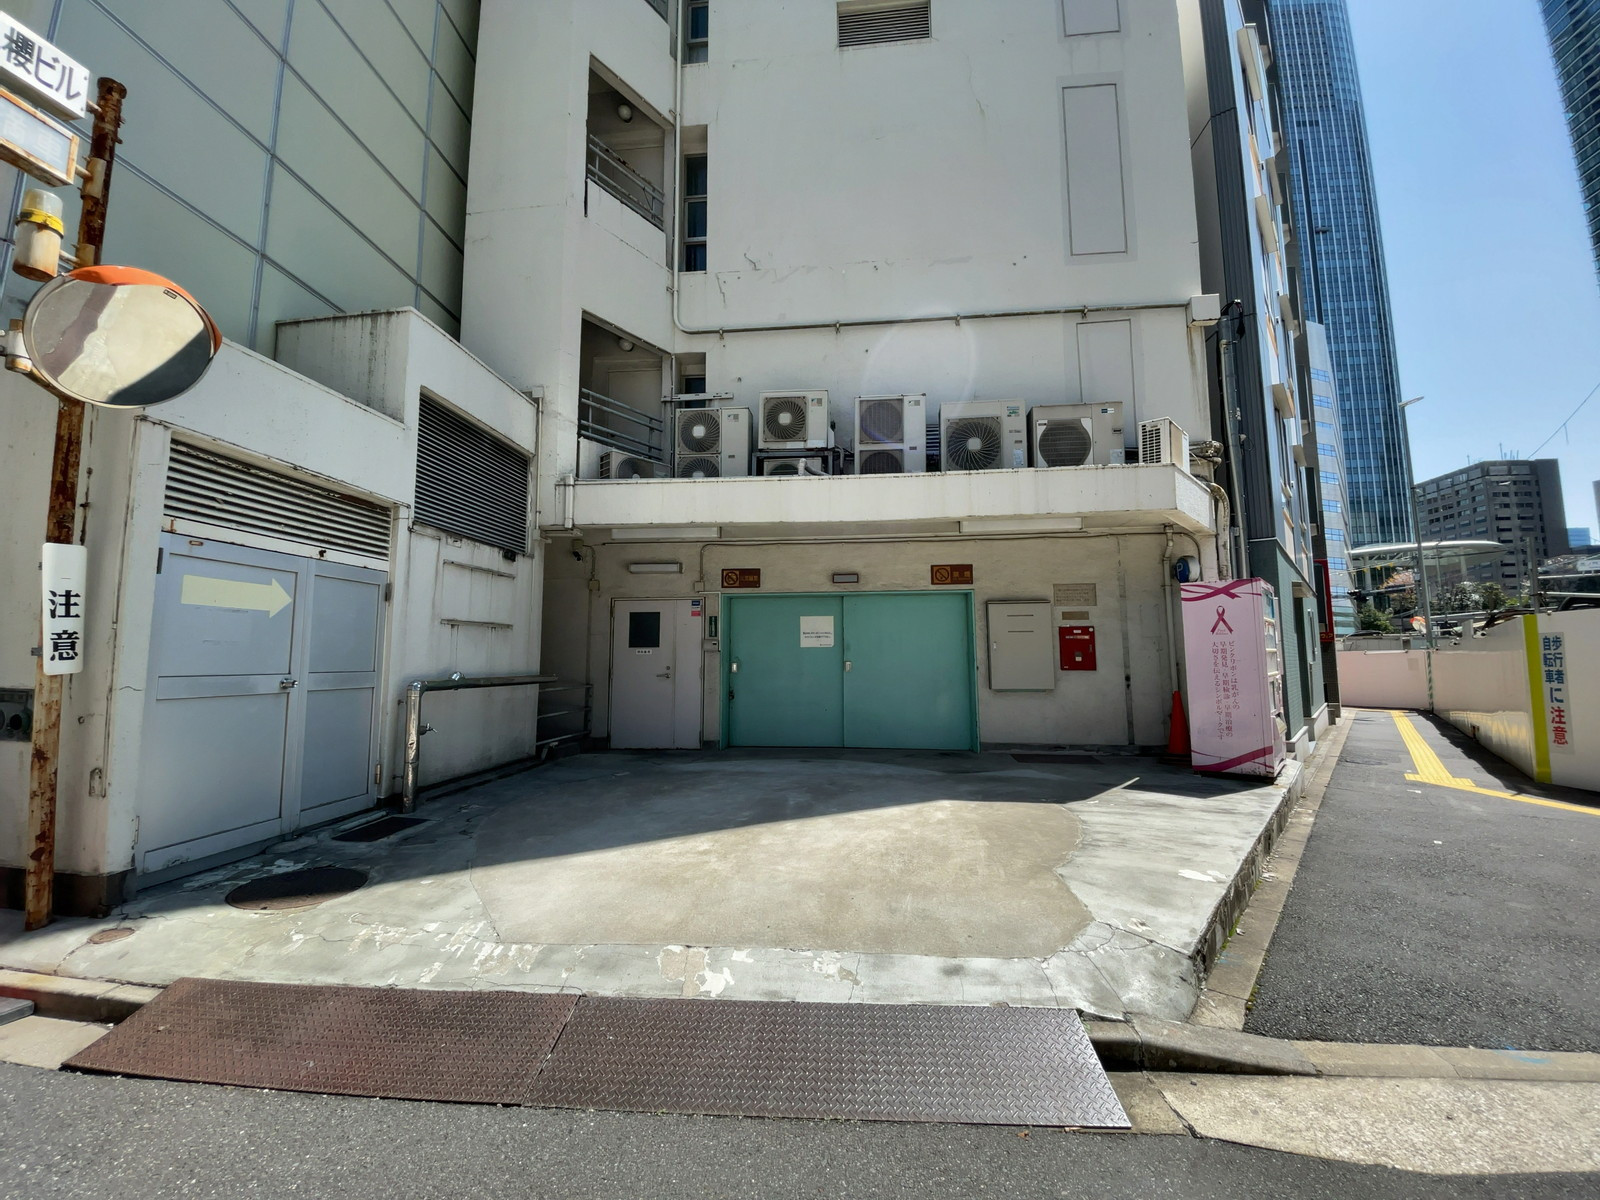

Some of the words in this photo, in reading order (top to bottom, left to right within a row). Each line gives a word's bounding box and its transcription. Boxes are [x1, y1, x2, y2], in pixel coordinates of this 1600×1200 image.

[2, 26, 81, 100] 櫻ビル
[48, 589, 81, 662] 注意
[1542, 635, 1555, 684] 自転車
[1551, 635, 1565, 685] 歩行者
